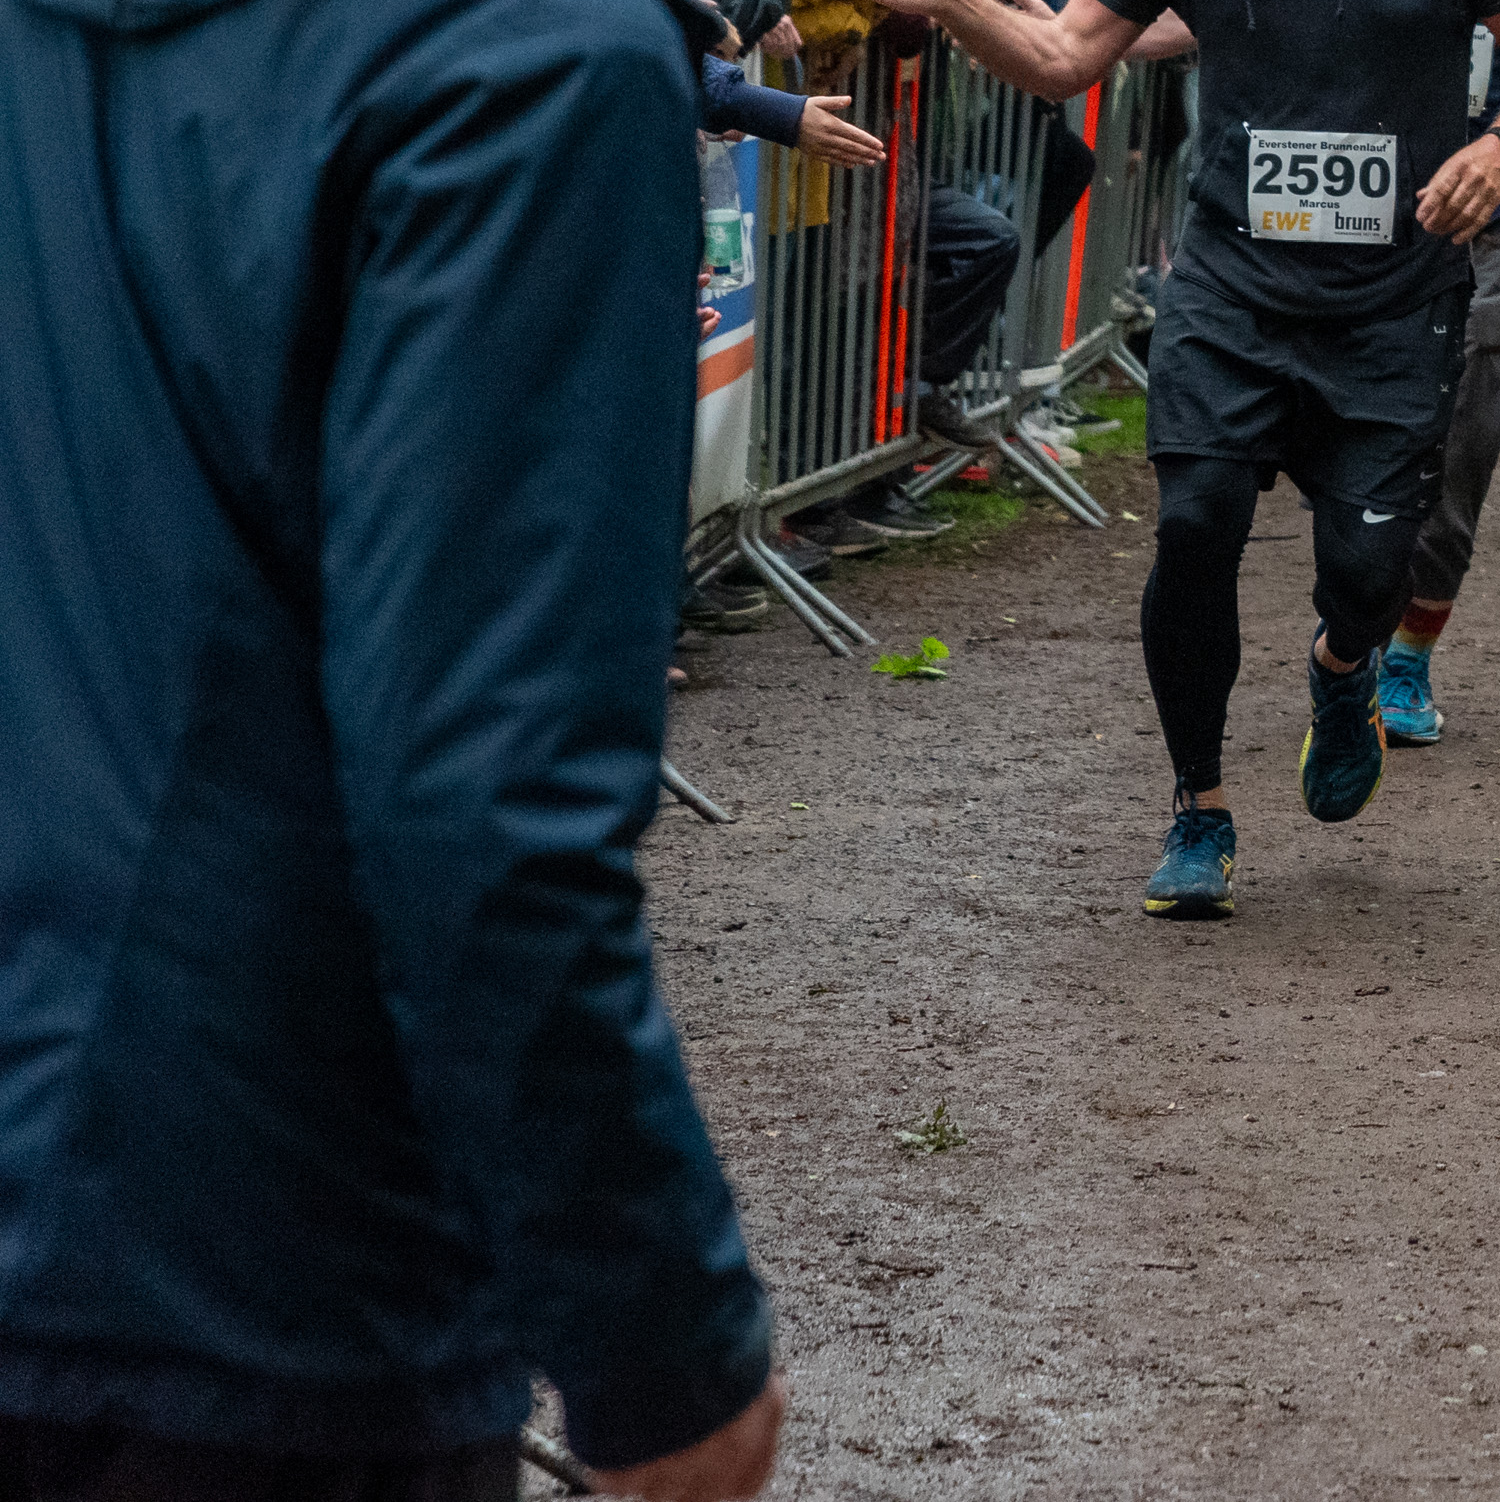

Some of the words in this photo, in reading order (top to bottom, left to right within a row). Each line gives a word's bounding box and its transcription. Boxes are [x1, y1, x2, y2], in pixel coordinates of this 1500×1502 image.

[1258, 139, 1318, 150] Everstener
[1320, 141, 1387, 153] Brunnenlauf
[1252, 153, 1391, 198] 2590
[1299, 199, 1341, 209] Marcus
[1262, 210, 1313, 232] EWE
[1334, 211, 1381, 231] bruns
